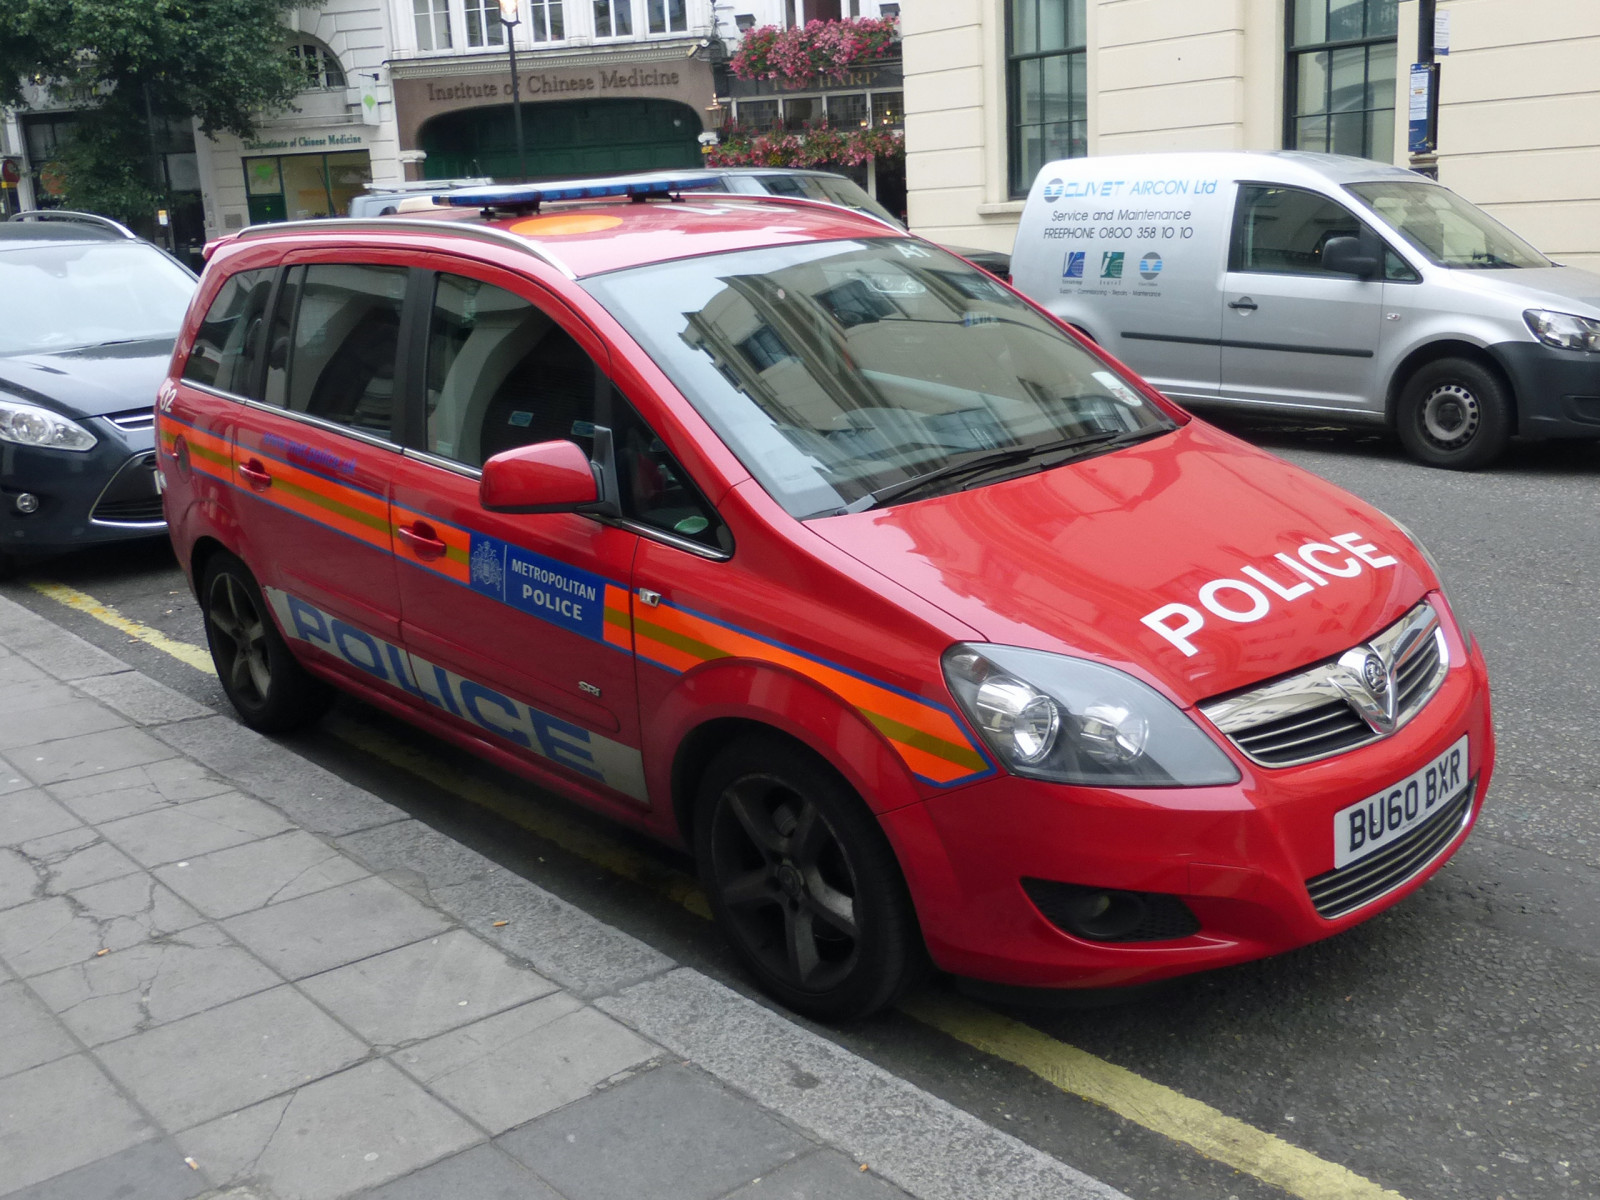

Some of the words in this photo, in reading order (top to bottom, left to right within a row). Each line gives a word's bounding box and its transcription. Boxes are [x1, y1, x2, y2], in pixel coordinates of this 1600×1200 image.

[427, 82, 498, 101] Institute
[527, 75, 595, 95] Chinese
[599, 69, 680, 89] Medicine
[299, 136, 326, 147] Chinese
[328, 134, 362, 146] Medicine
[1129, 180, 1189, 196] AIRCON
[1193, 179, 1218, 195] Ltd
[1051, 210, 1089, 222] Service
[1092, 209, 1114, 221] and
[1117, 209, 1192, 221] Maintenance
[1043, 227, 1095, 240] FREEPHONE
[1098, 226, 1132, 239] 0800
[1136, 226, 1157, 239] 358
[1161, 226, 1175, 239] 10
[1179, 226, 1194, 239] 10
[511, 558, 597, 602] METROPOLITAN
[1139, 532, 1398, 658] POLICE
[522, 584, 583, 621] POLICE
[287, 594, 607, 785] POLICE
[1349, 779, 1419, 853] BU60
[1425, 748, 1461, 810] BXR
